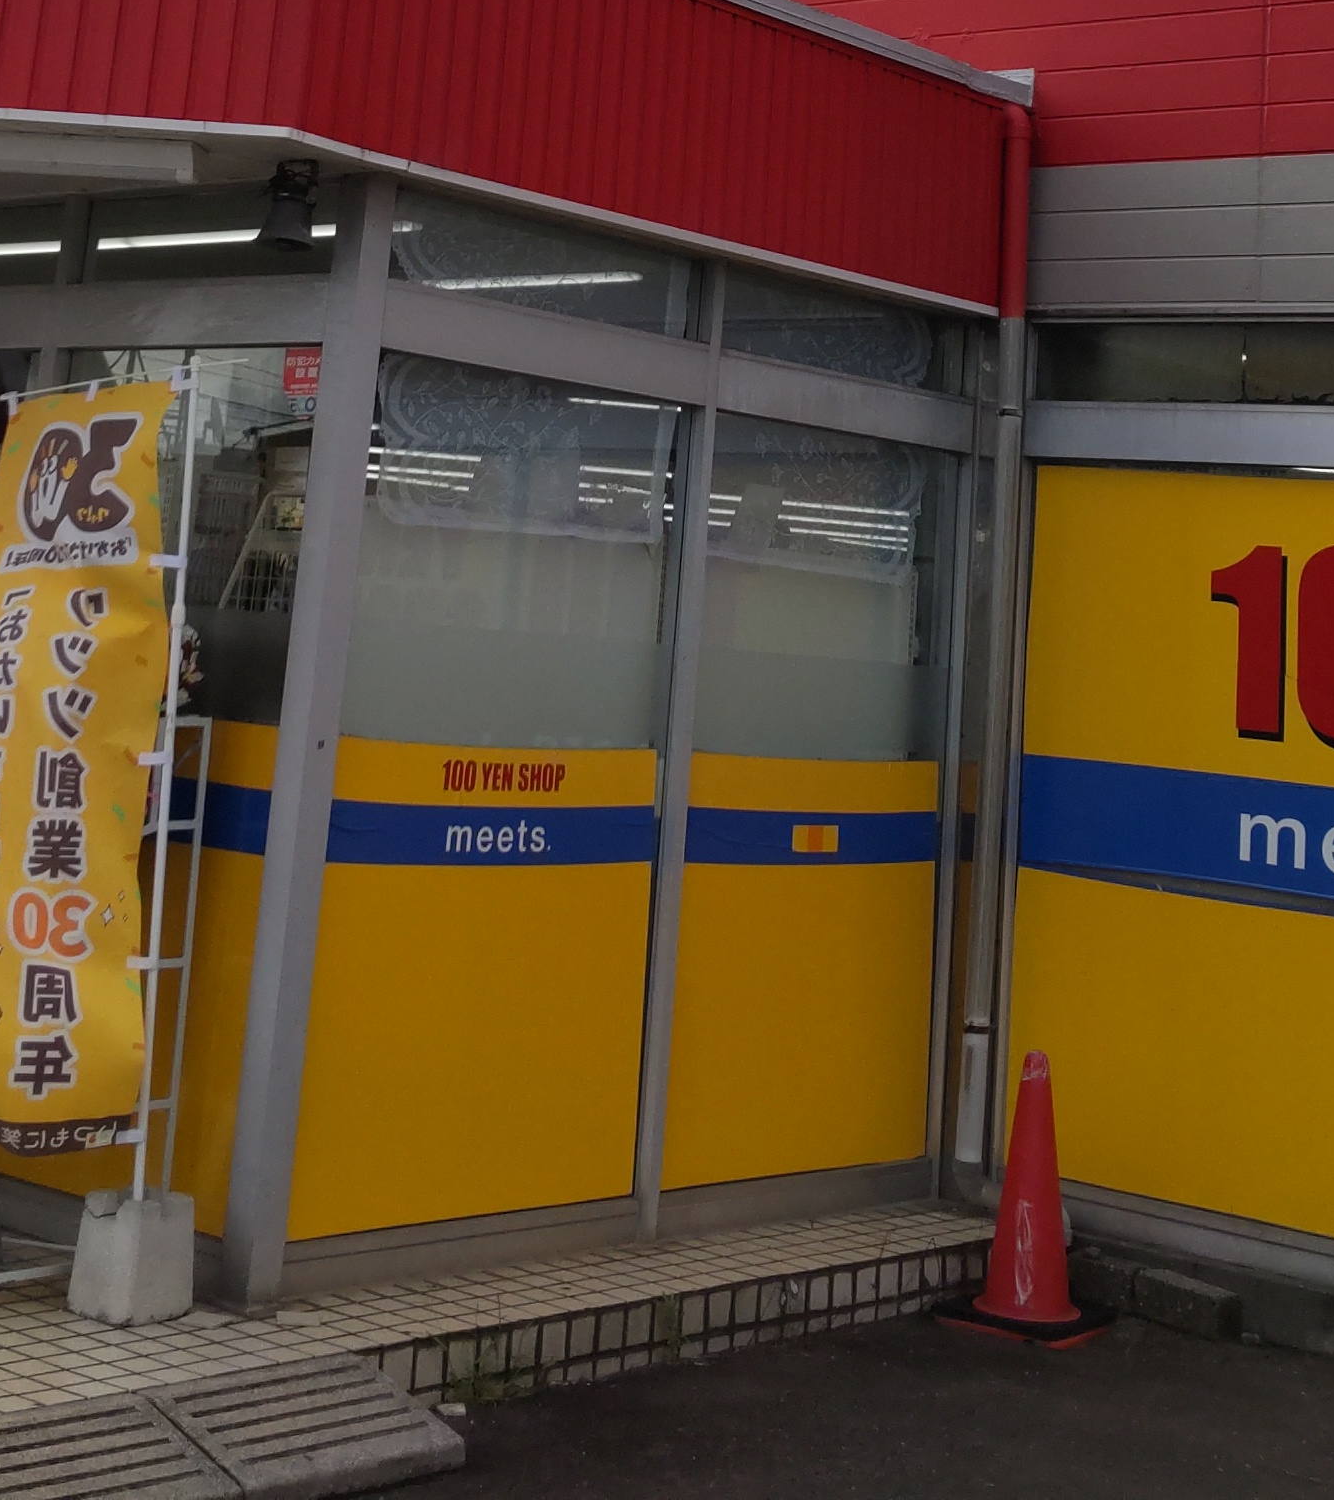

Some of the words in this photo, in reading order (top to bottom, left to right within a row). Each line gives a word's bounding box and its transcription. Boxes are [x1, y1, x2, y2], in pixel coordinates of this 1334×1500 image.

[442, 759, 476, 792] 100
[481, 761, 514, 792] YEN
[518, 763, 566, 793] SHOP
[445, 820, 552, 854] meets.
